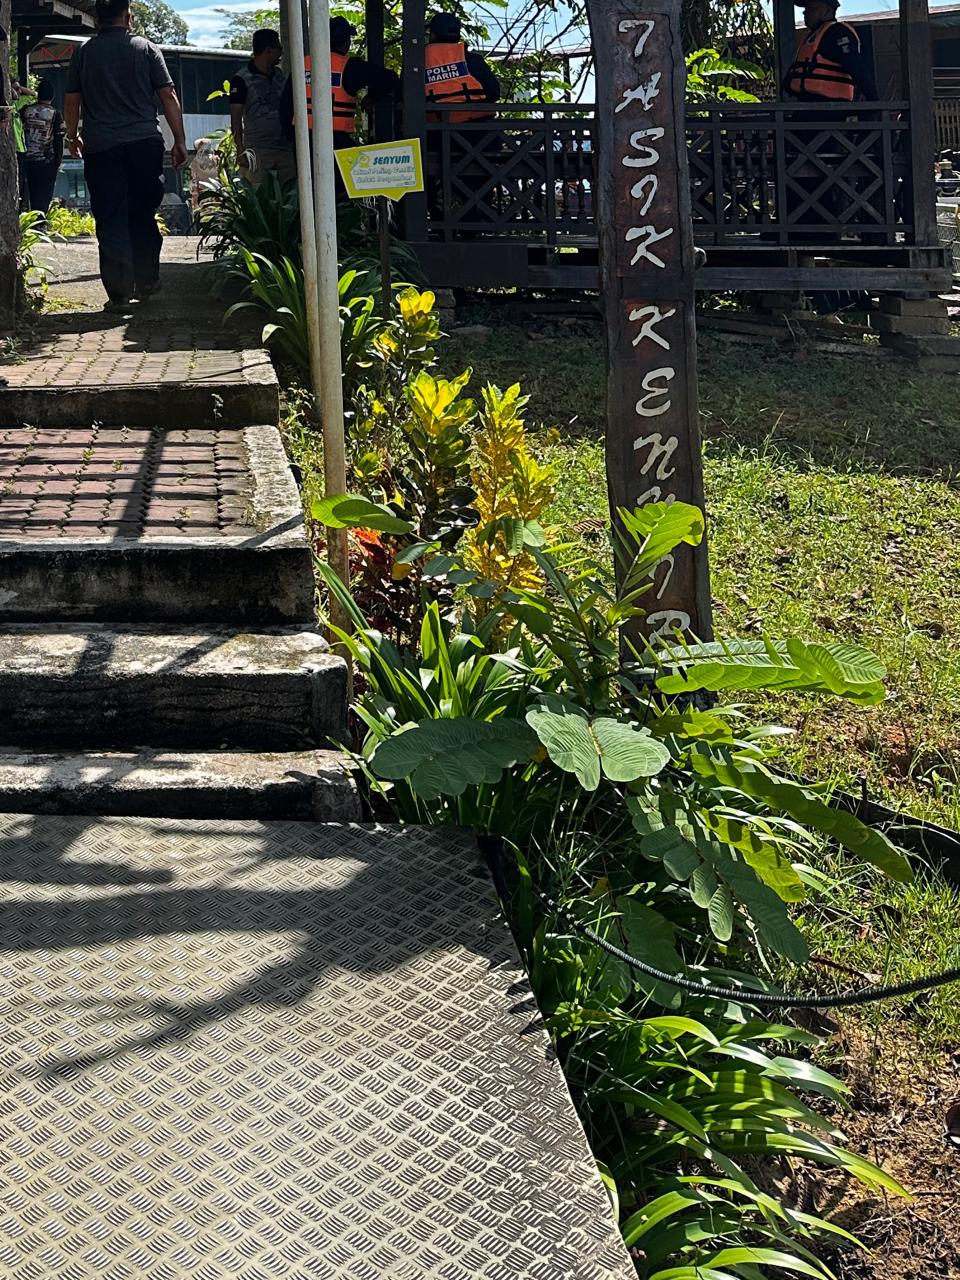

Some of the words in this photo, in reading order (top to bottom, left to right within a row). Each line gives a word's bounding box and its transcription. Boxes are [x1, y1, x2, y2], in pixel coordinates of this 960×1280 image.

[426, 64, 458, 76] POLIS
[427, 70, 460, 83] MARIN
[614, 19, 674, 269] TASIK
[373, 155, 411, 166] SENYUM
